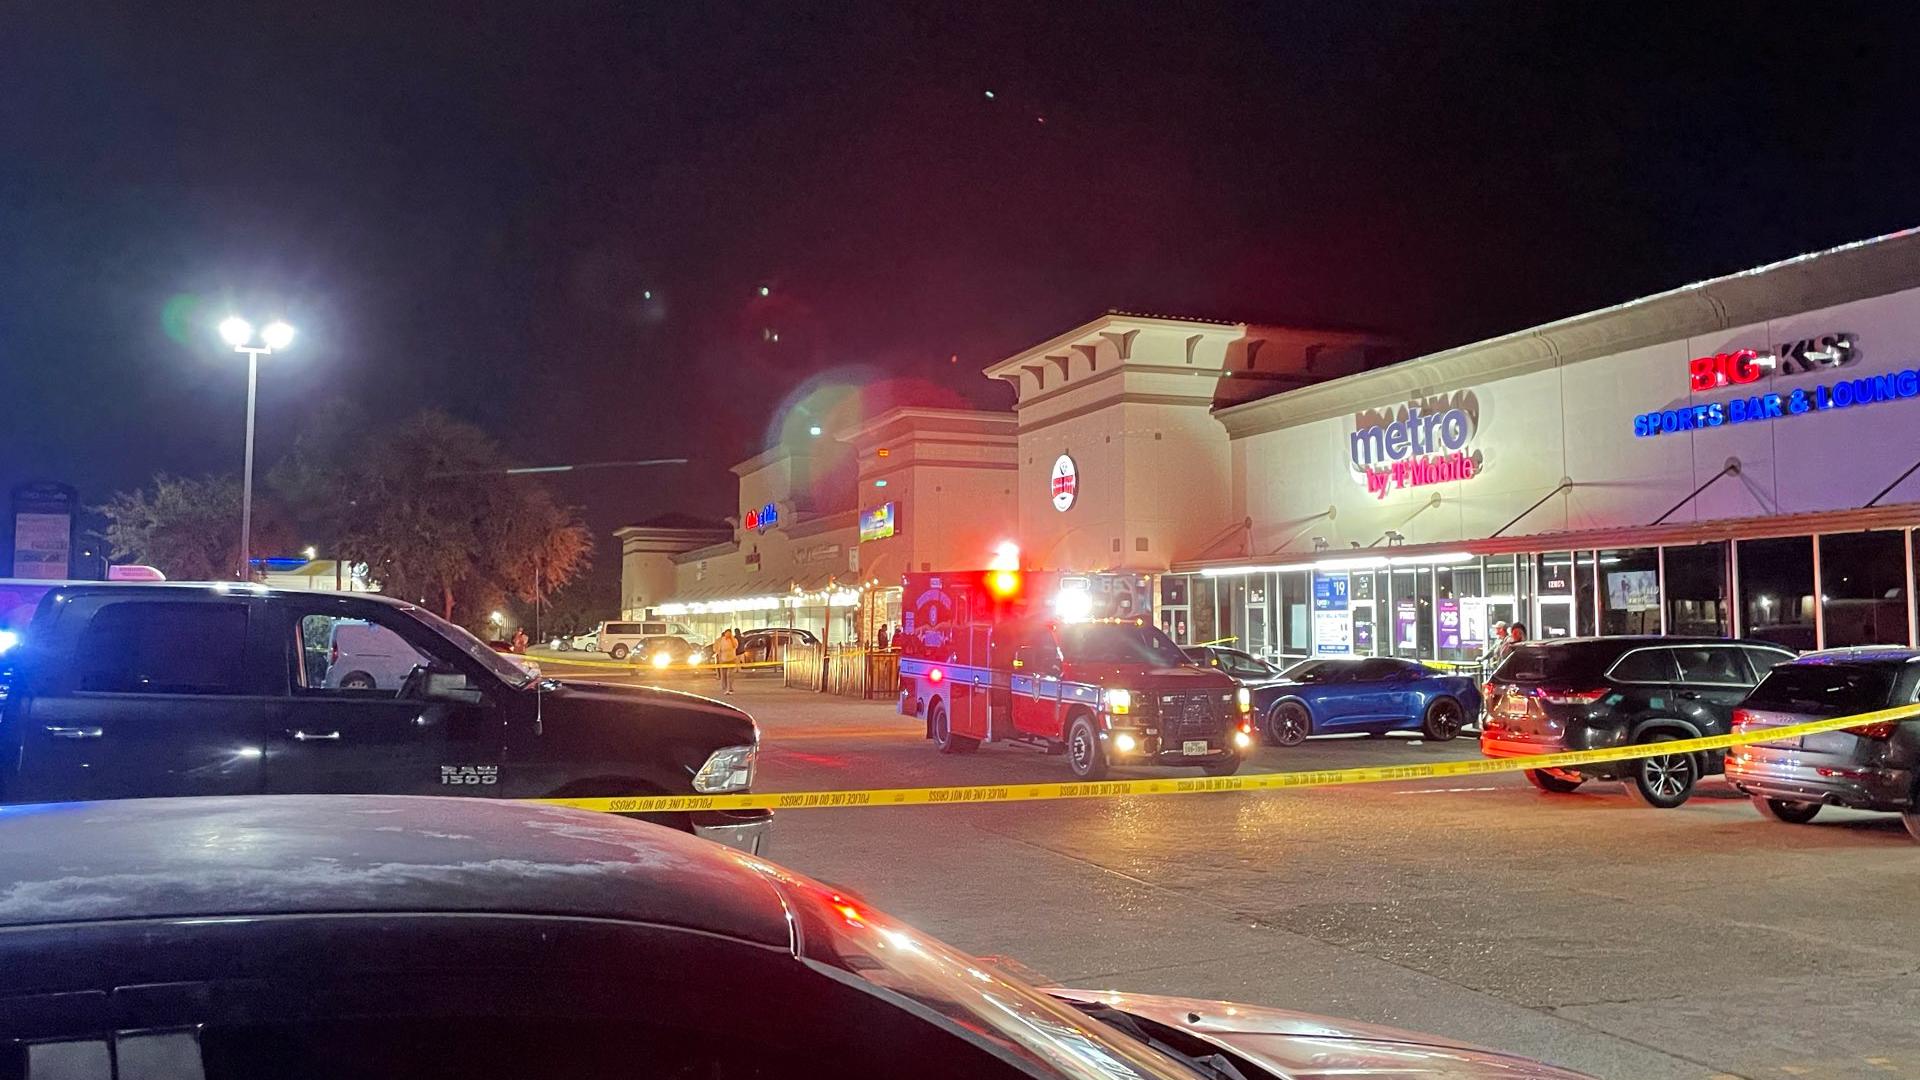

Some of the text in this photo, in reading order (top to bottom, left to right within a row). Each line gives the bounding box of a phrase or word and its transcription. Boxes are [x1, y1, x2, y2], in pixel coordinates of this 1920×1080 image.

[1689, 349, 1761, 392] BIG
[1634, 368, 1920, 438] SPORTS BAR & LOUNG
[1350, 407, 1469, 465] metro
[1366, 466, 1390, 500] by
[441, 775, 498, 785] 1500
[668, 798, 685, 810] LINE
[688, 798, 713, 809] POLICE
[780, 796, 804, 807] CROSS
[804, 795, 818, 806] NOT
[830, 794, 846, 805] LINE
[847, 793, 870, 804] POLICE
[608, 800, 637, 810] CROSS
[638, 800, 654, 810] NOT
